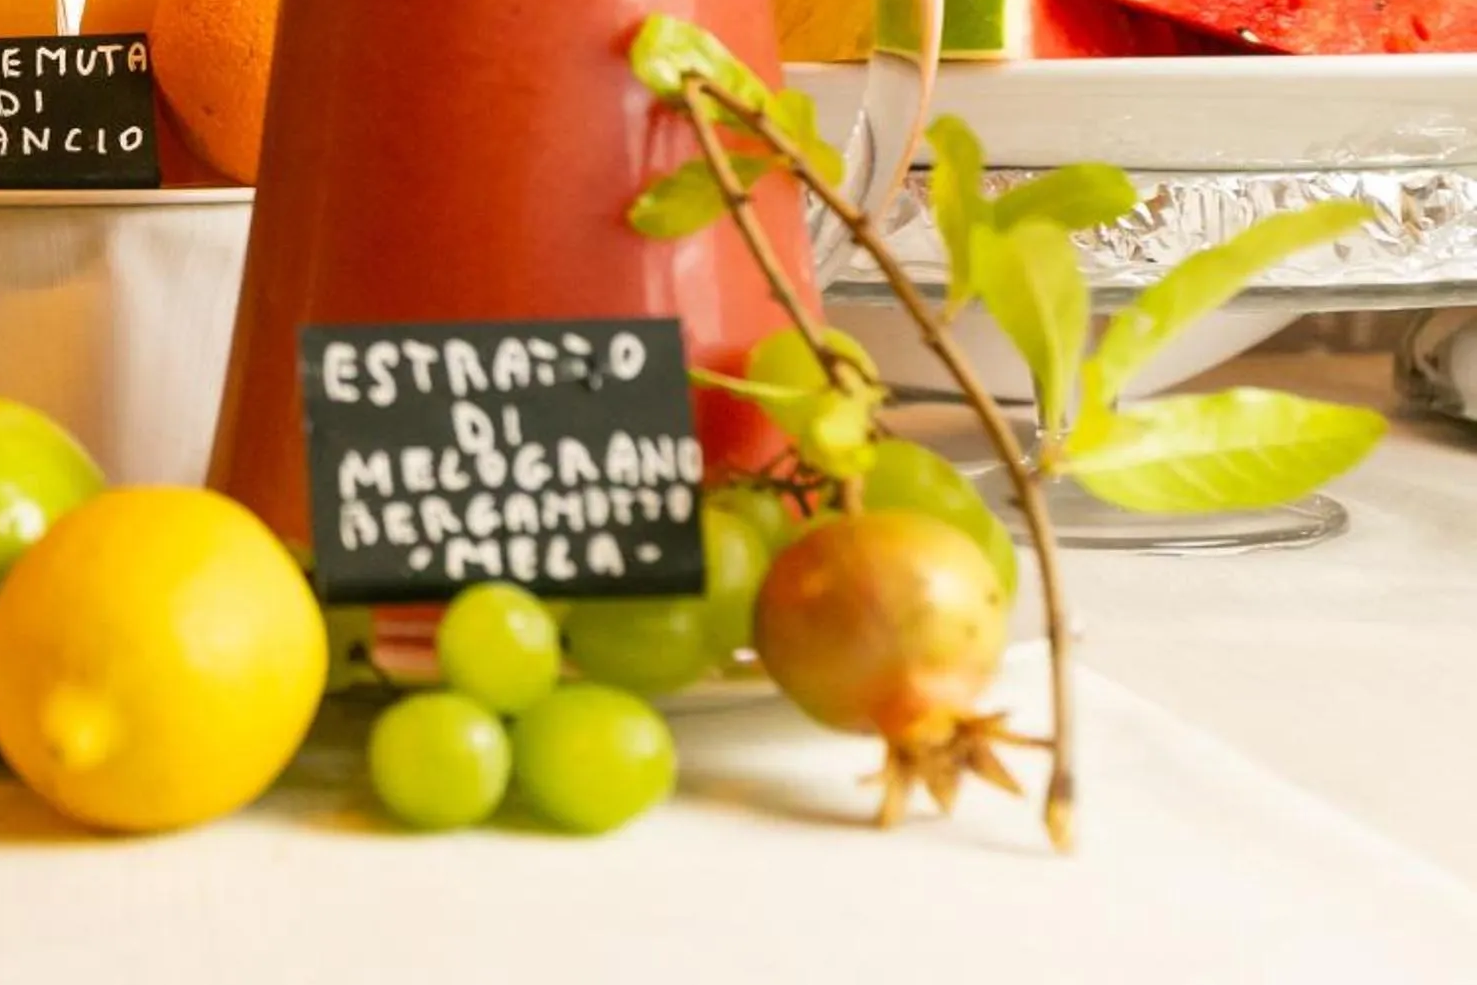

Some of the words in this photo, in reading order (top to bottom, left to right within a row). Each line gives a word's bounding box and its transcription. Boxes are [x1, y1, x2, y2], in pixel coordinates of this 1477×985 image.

[450, 399, 522, 456] DI
[337, 428, 705, 501] MELOGRANO
[338, 482, 694, 552] BERGAMOTTO
